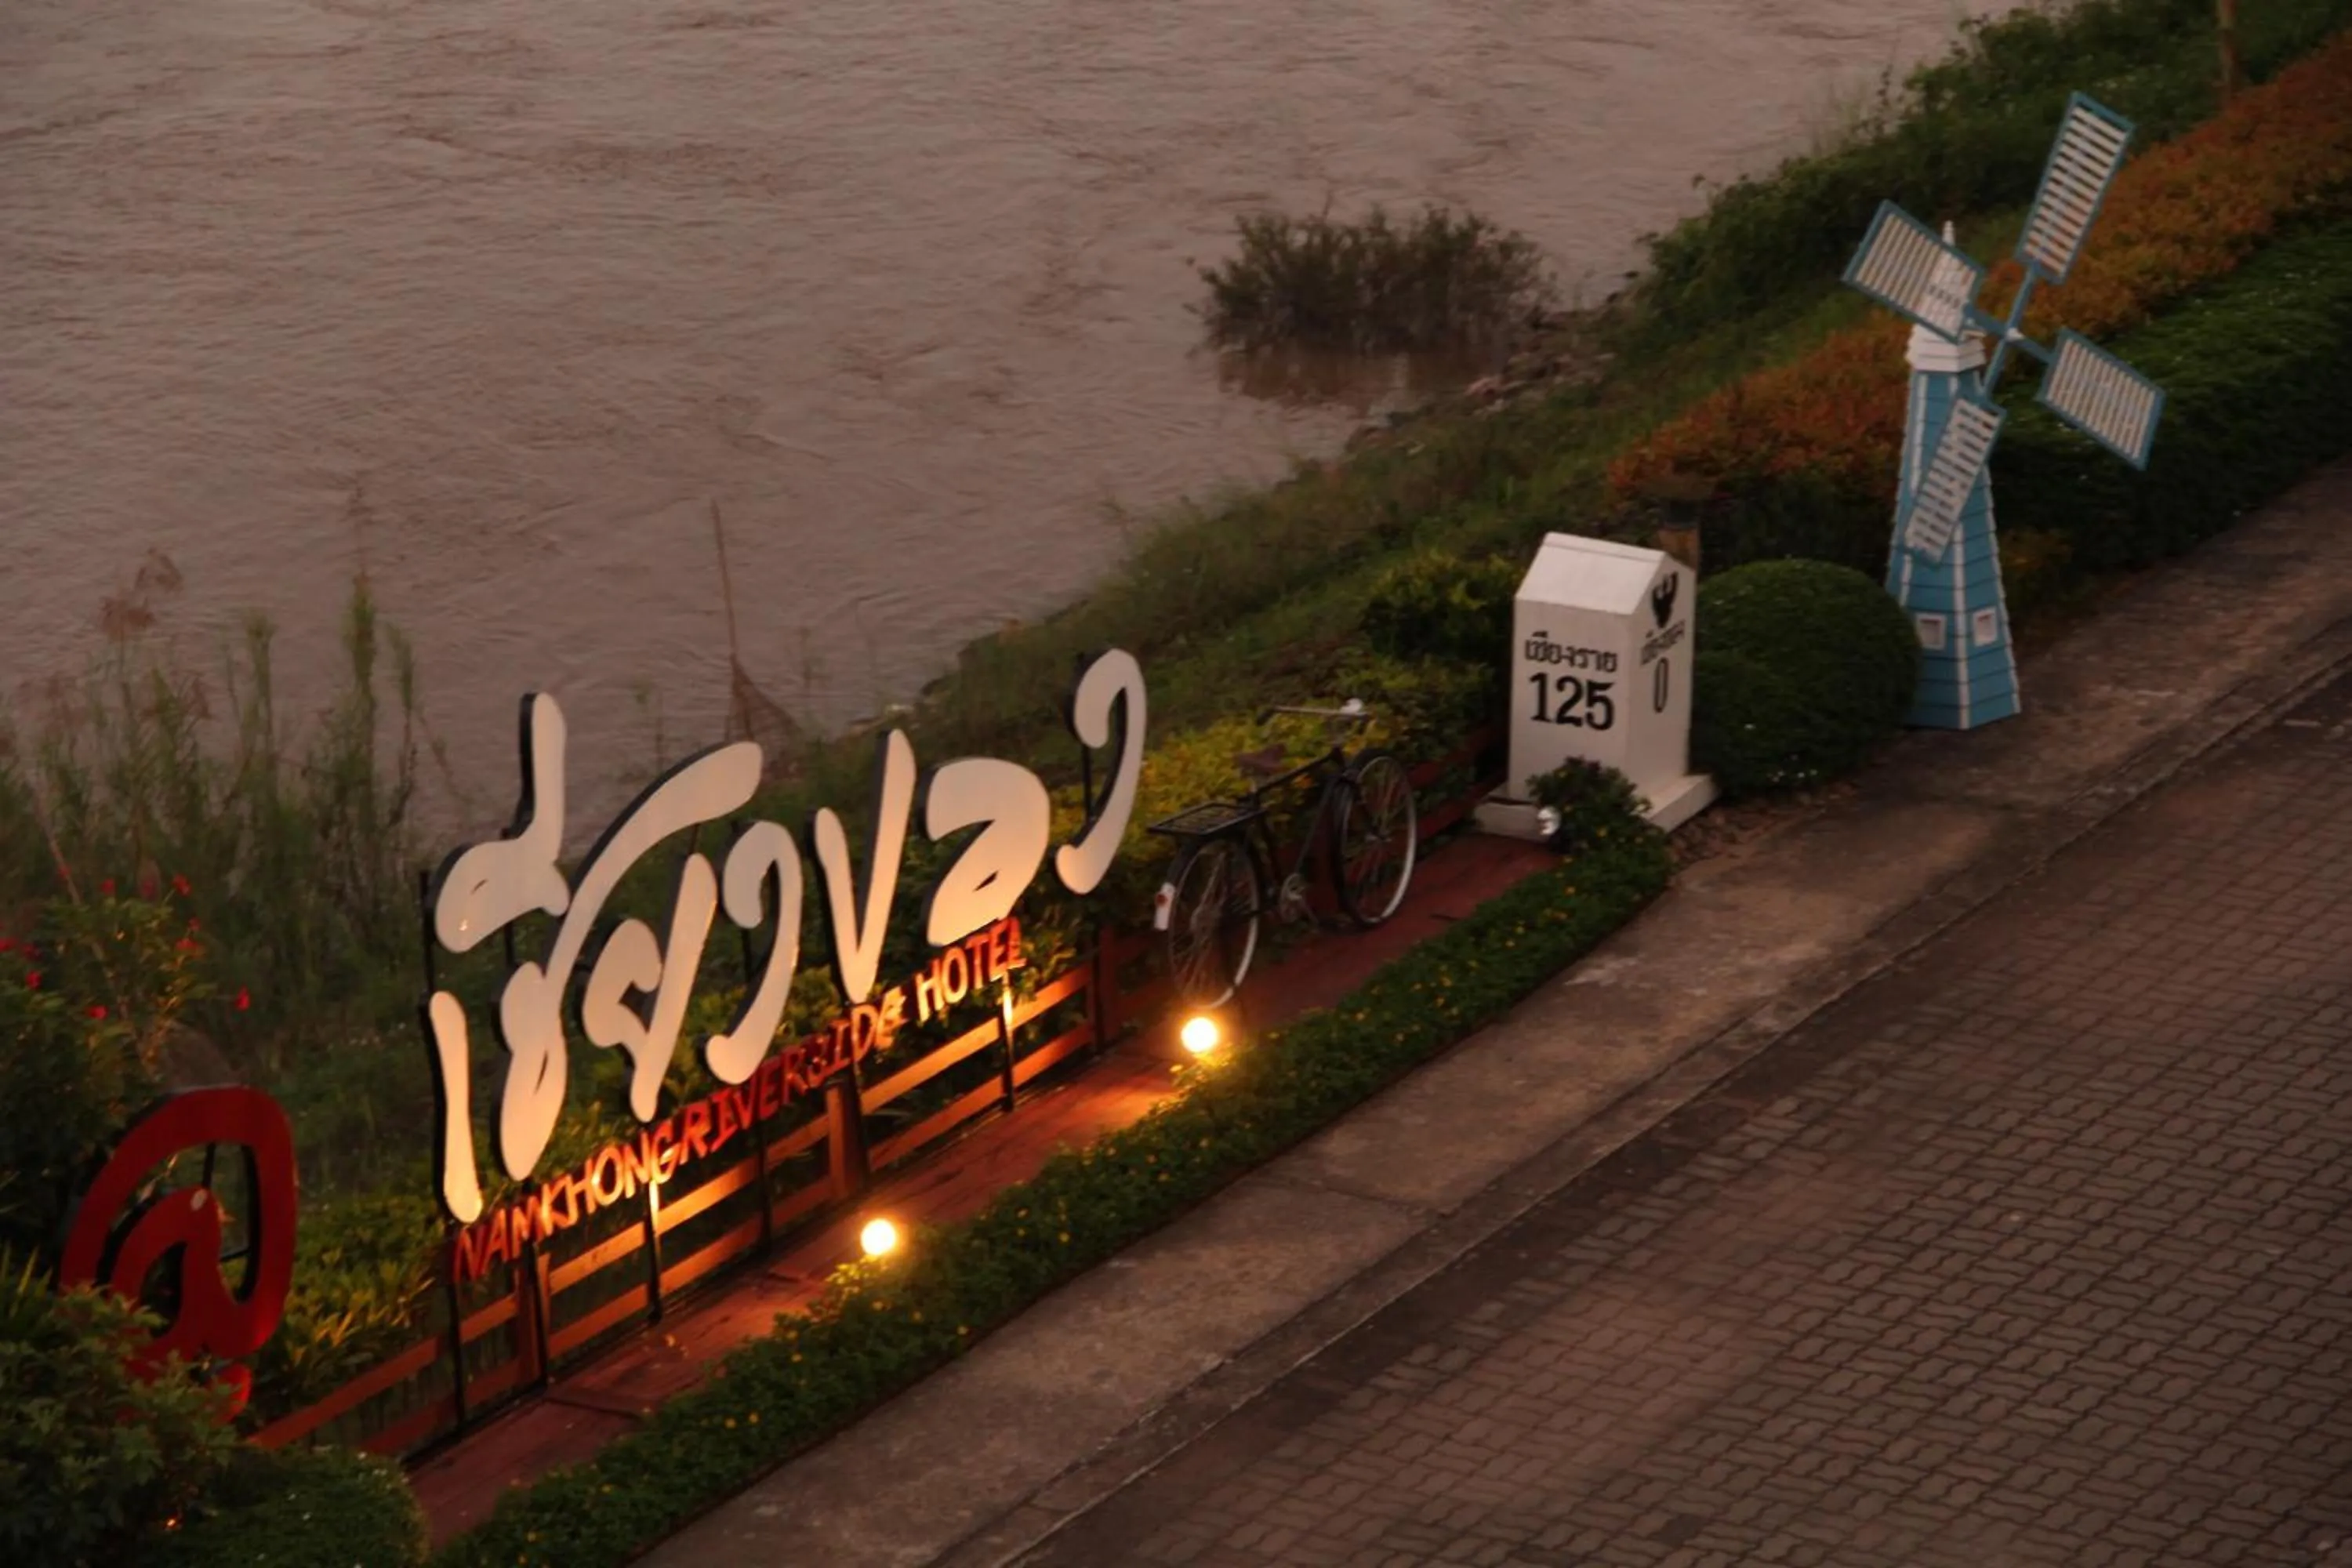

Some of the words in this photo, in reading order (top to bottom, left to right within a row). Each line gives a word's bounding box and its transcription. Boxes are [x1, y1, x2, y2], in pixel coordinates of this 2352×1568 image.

[1524, 630, 1618, 673] เชียงราย
[1529, 672, 1617, 731] 125
[1653, 656, 1669, 714] 0
[915, 916, 1027, 1022] HOTEL
